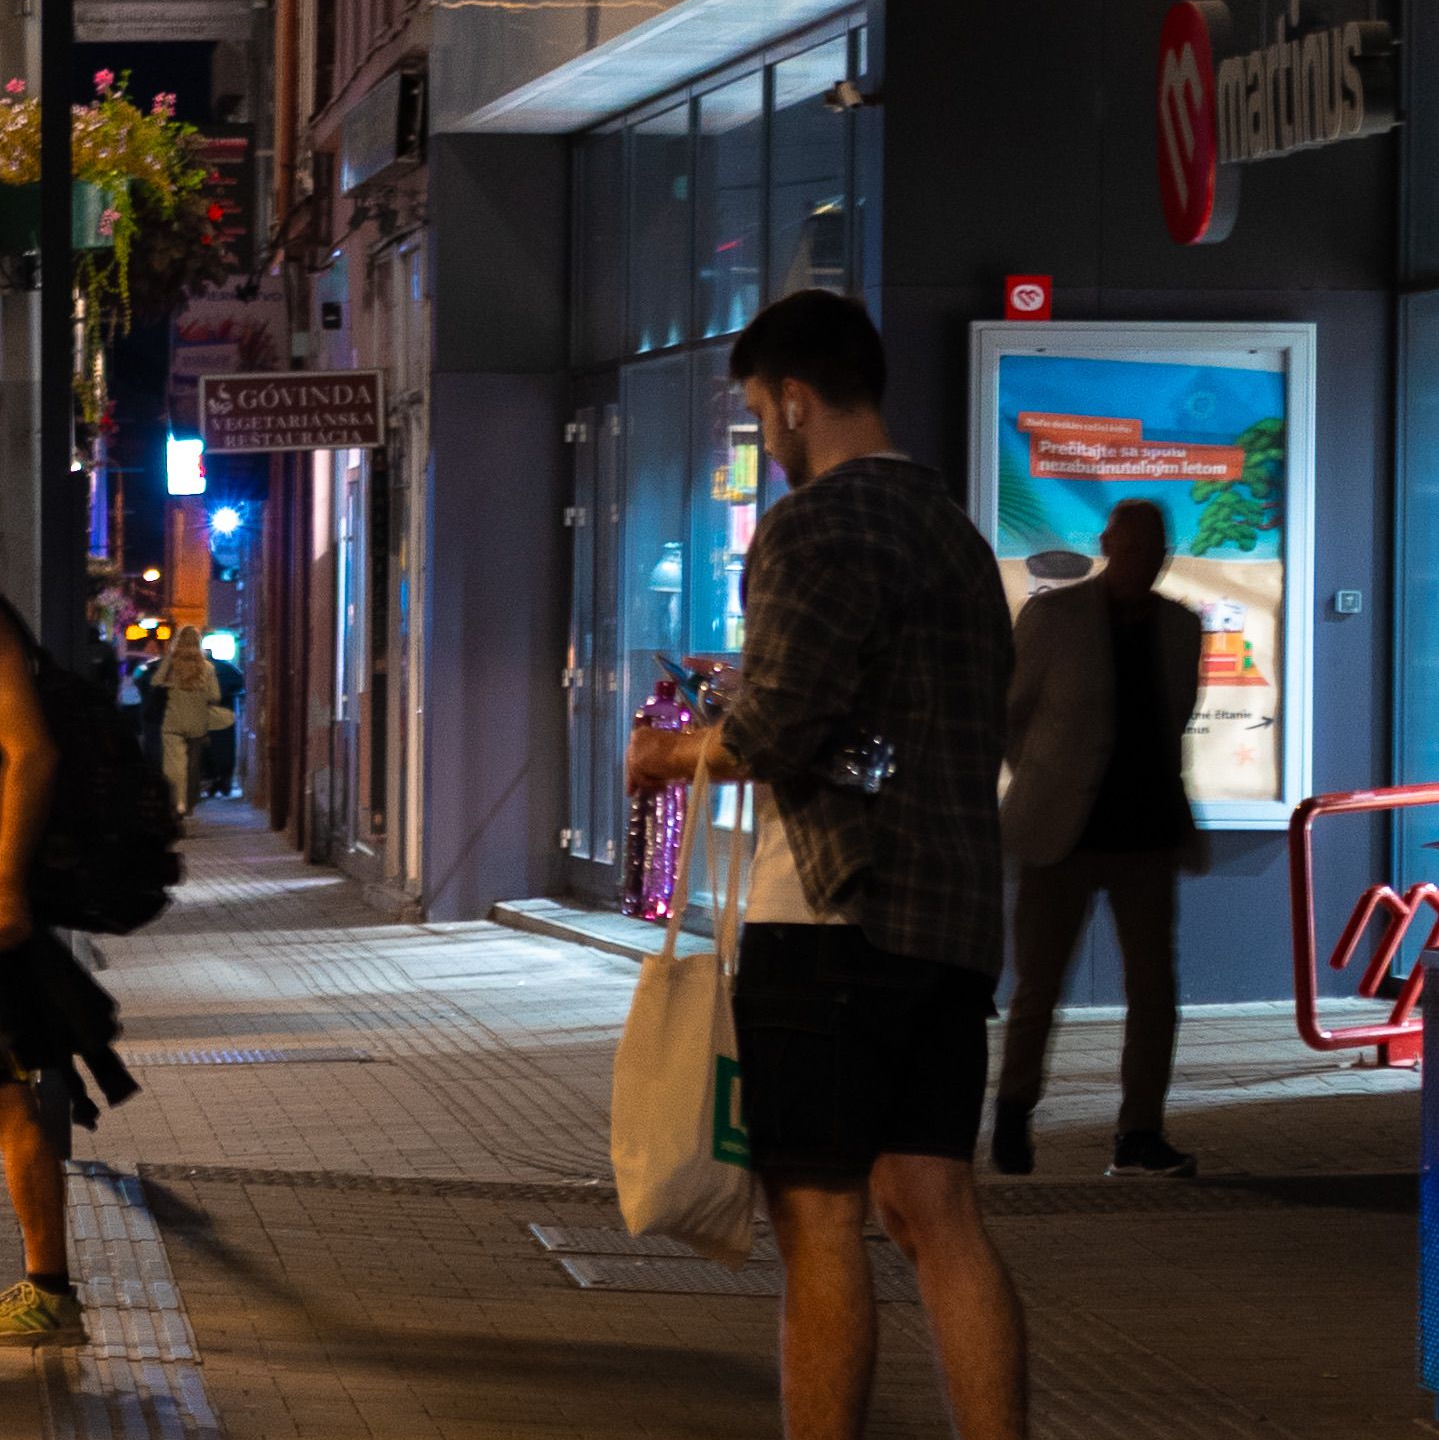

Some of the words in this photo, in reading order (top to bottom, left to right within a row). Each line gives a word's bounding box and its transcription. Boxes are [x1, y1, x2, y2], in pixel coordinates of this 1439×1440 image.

[238, 383, 373, 409] GÓVINDA
[210, 412, 375, 431] VEGETARIÁNSKA
[1120, 448, 1139, 457] sa
[1182, 461, 1227, 474] letom
